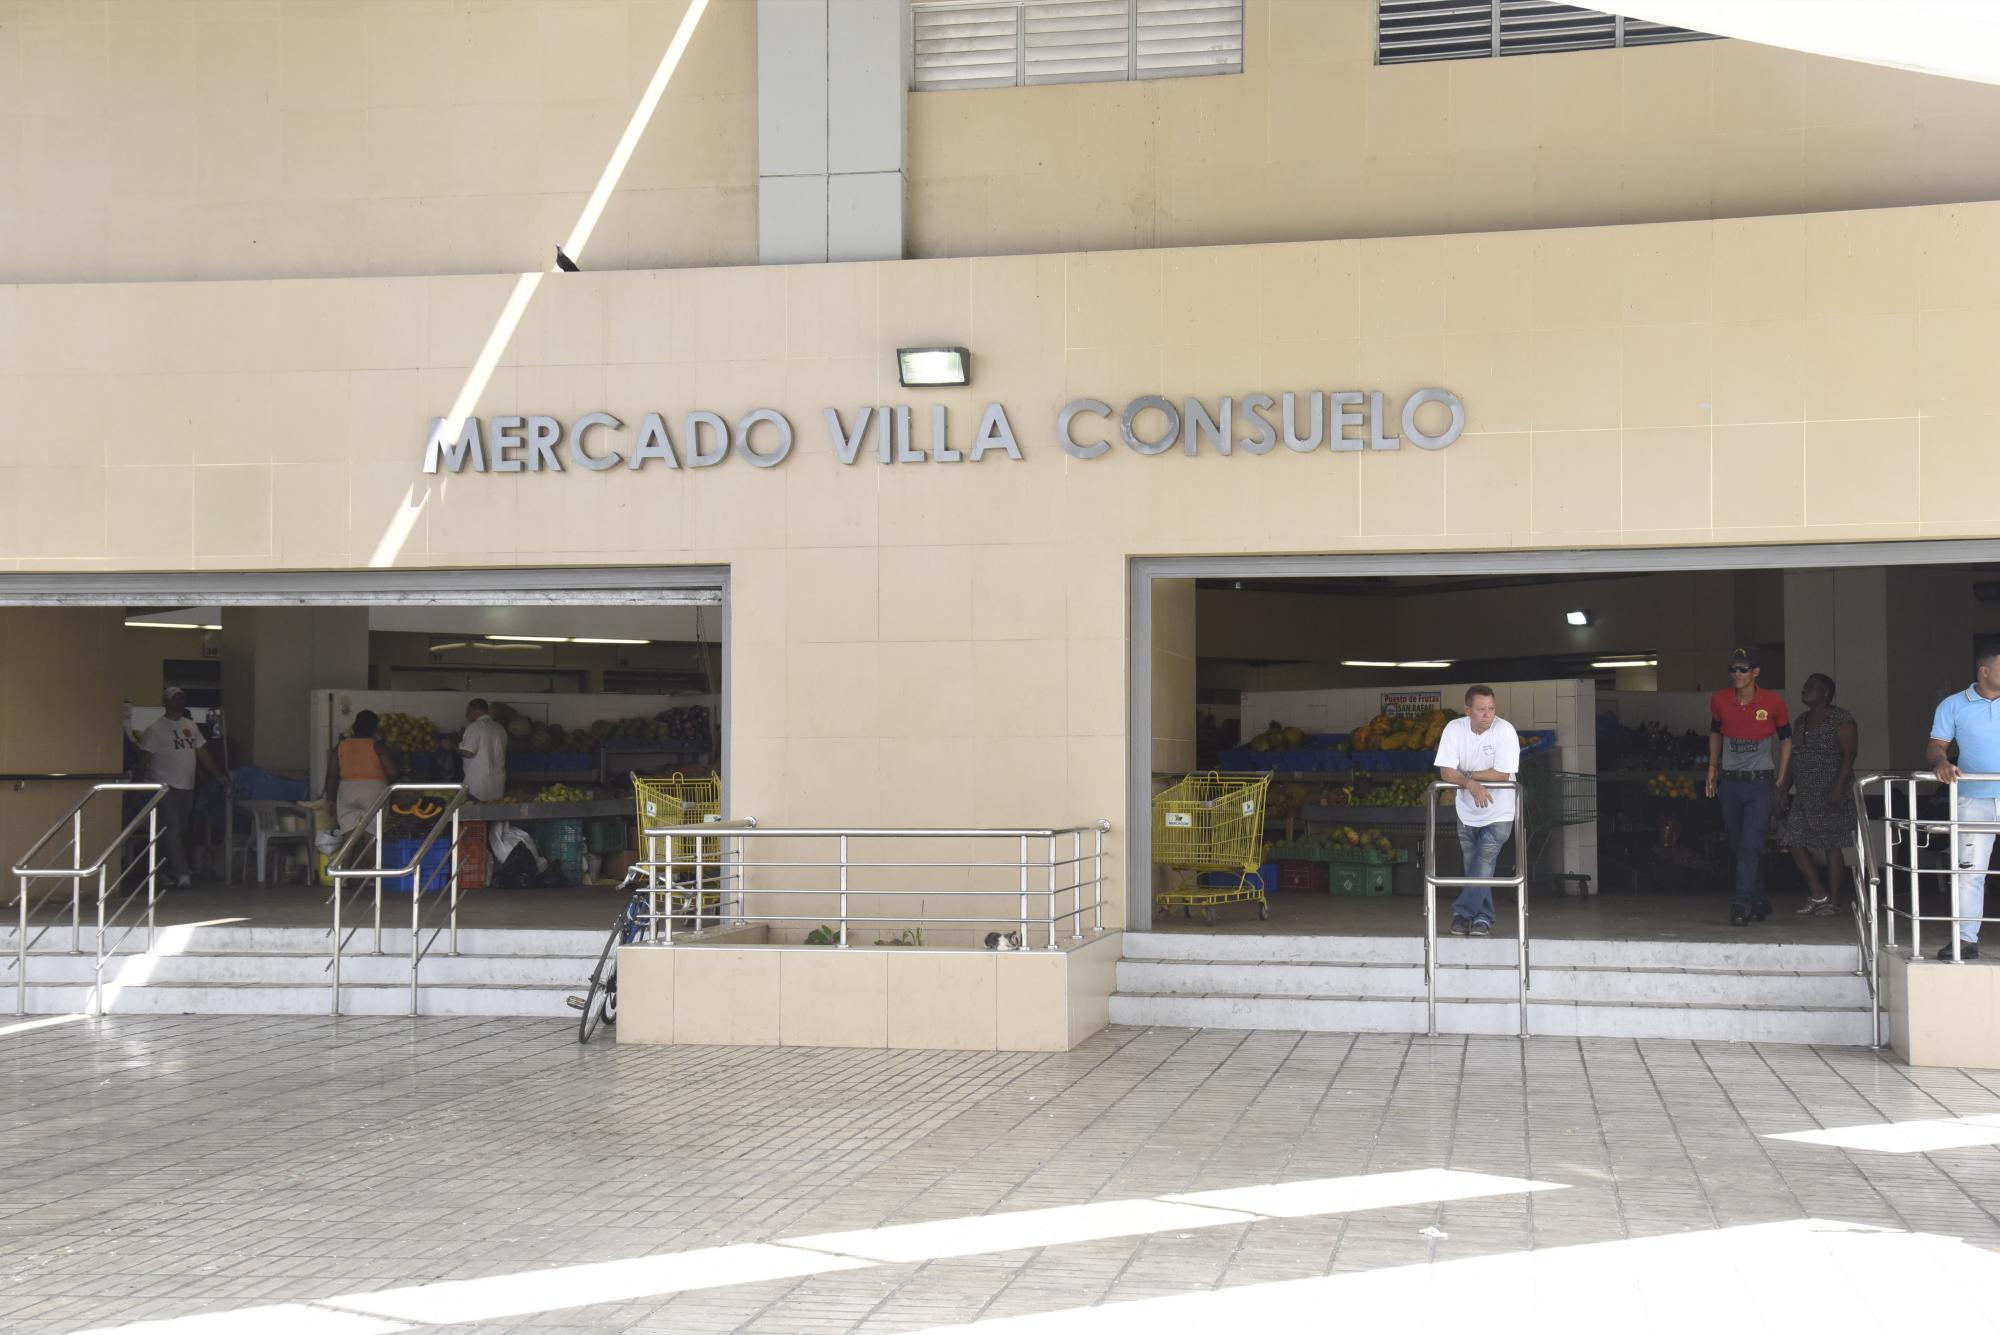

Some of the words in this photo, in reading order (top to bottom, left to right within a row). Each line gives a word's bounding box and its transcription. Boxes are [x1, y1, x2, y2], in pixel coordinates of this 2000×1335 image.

[422, 407, 795, 474] MERCADO
[824, 402, 1023, 466] VILLA
[1056, 387, 1466, 460] CONSUELO
[1384, 694, 1407, 704] Puesto
[1408, 695, 1417, 703] de
[1418, 694, 1440, 703] Frutas
[1398, 704, 1411, 712] SAN
[173, 738, 196, 750] NY
